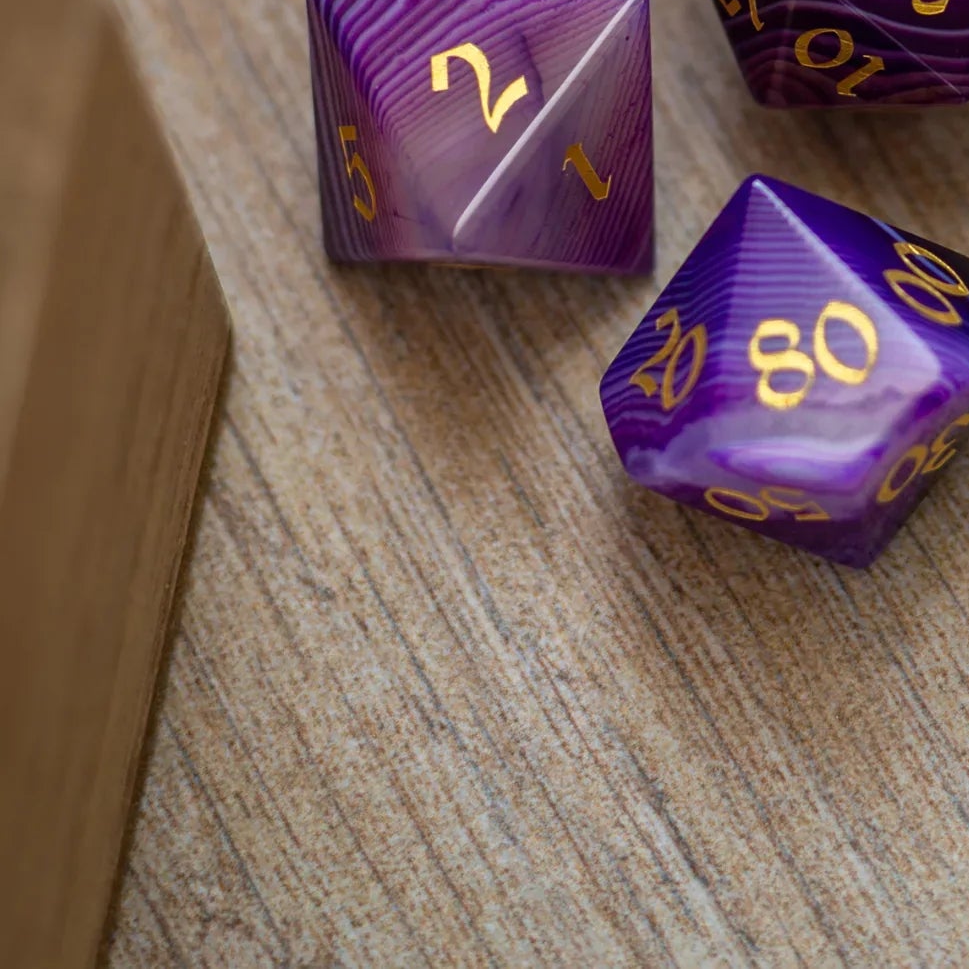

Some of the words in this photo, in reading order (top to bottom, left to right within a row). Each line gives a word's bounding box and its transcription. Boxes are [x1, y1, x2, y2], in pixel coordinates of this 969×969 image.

[431, 42, 529, 134] 2
[794, 27, 886, 98] 10
[338, 125, 377, 223] 5
[562, 142, 613, 201] 1
[628, 307, 708, 411] 20
[747, 299, 878, 411] 80
[704, 486, 831, 522] 50
